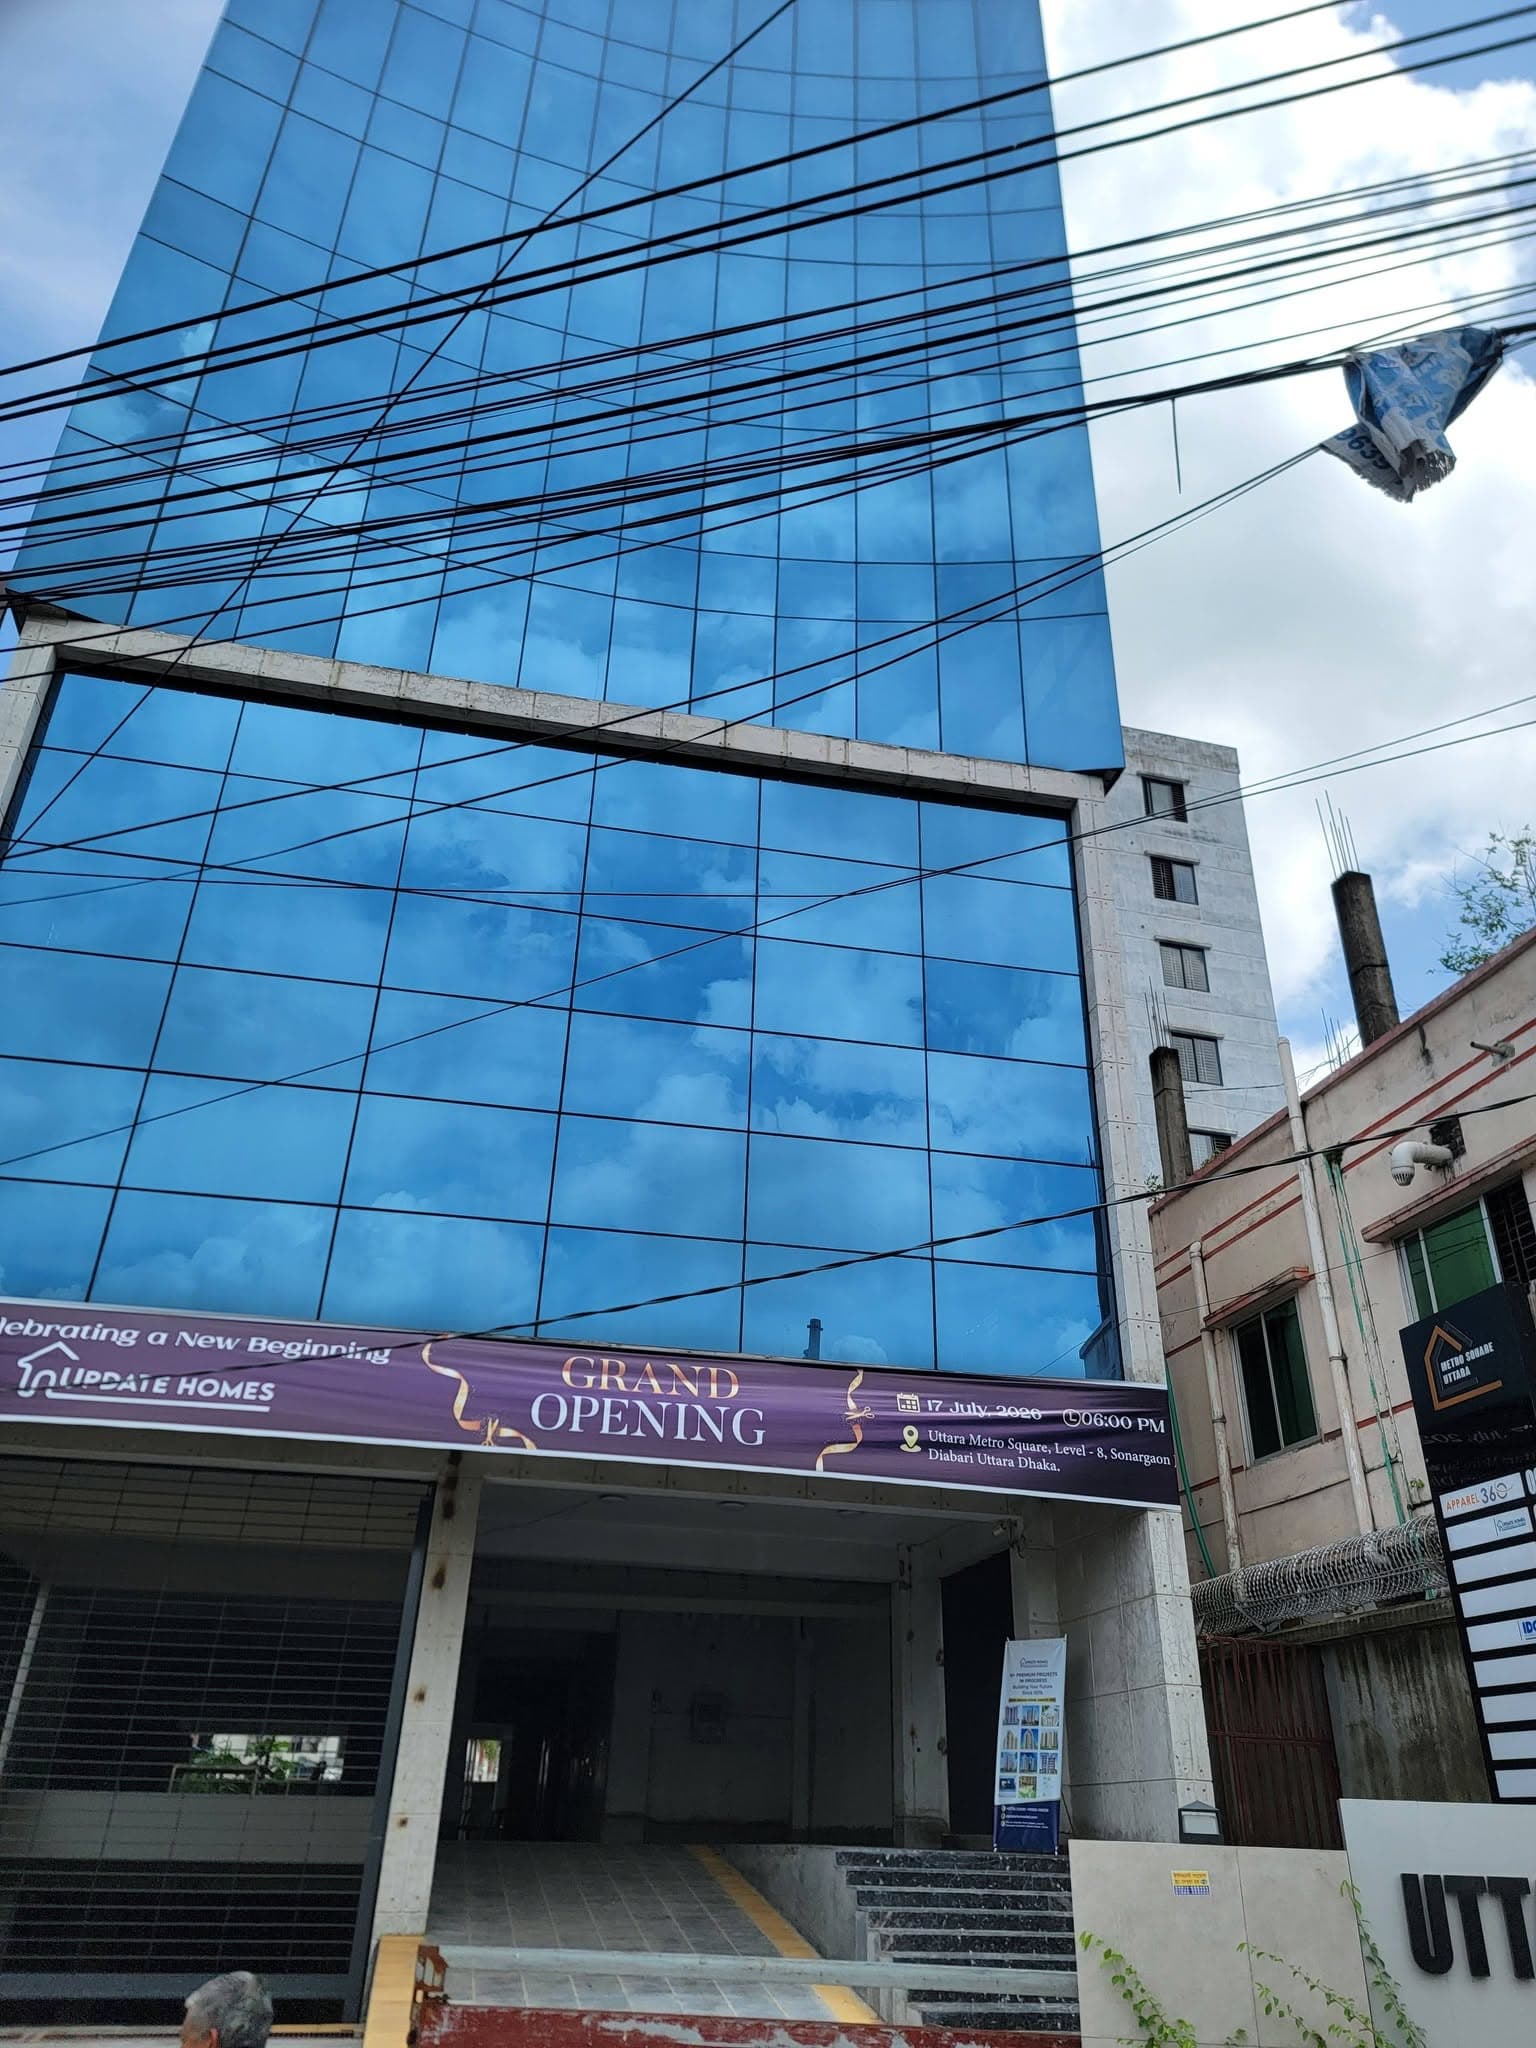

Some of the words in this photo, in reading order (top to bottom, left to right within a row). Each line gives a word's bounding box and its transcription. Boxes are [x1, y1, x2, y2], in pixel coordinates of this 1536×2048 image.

[147, 1331, 169, 1346] a
[175, 1331, 241, 1351] New
[247, 1337, 392, 1365] Beginning
[1441, 1355, 1465, 1372] METRO
[1465, 1342, 1495, 1362] SQUARE
[60, 1367, 170, 1394] UPDATE
[176, 1377, 276, 1401] HOMES
[561, 1355, 739, 1400] GRAND
[1443, 1366, 1471, 1385] UTTARA
[530, 1392, 766, 1446] OPENING
[927, 1400, 943, 1412] 17
[1081, 1411, 1132, 1429] 06:00
[1137, 1418, 1165, 1433] PM
[928, 1430, 965, 1445] Uttara
[969, 1434, 1004, 1448] Metro
[1008, 1438, 1051, 1454] Square,
[1055, 1443, 1086, 1456] Level
[1097, 1447, 1107, 1460] 8,
[1110, 1448, 1171, 1467] Sonargaon
[928, 1448, 974, 1463] Diabari
[977, 1453, 1015, 1468] Uttara
[1018, 1457, 1060, 1472] Dhaka.
[1446, 1493, 1480, 1512] APPAREL
[1480, 1483, 1508, 1504] 360
[1400, 1873, 1536, 1979] UTT
